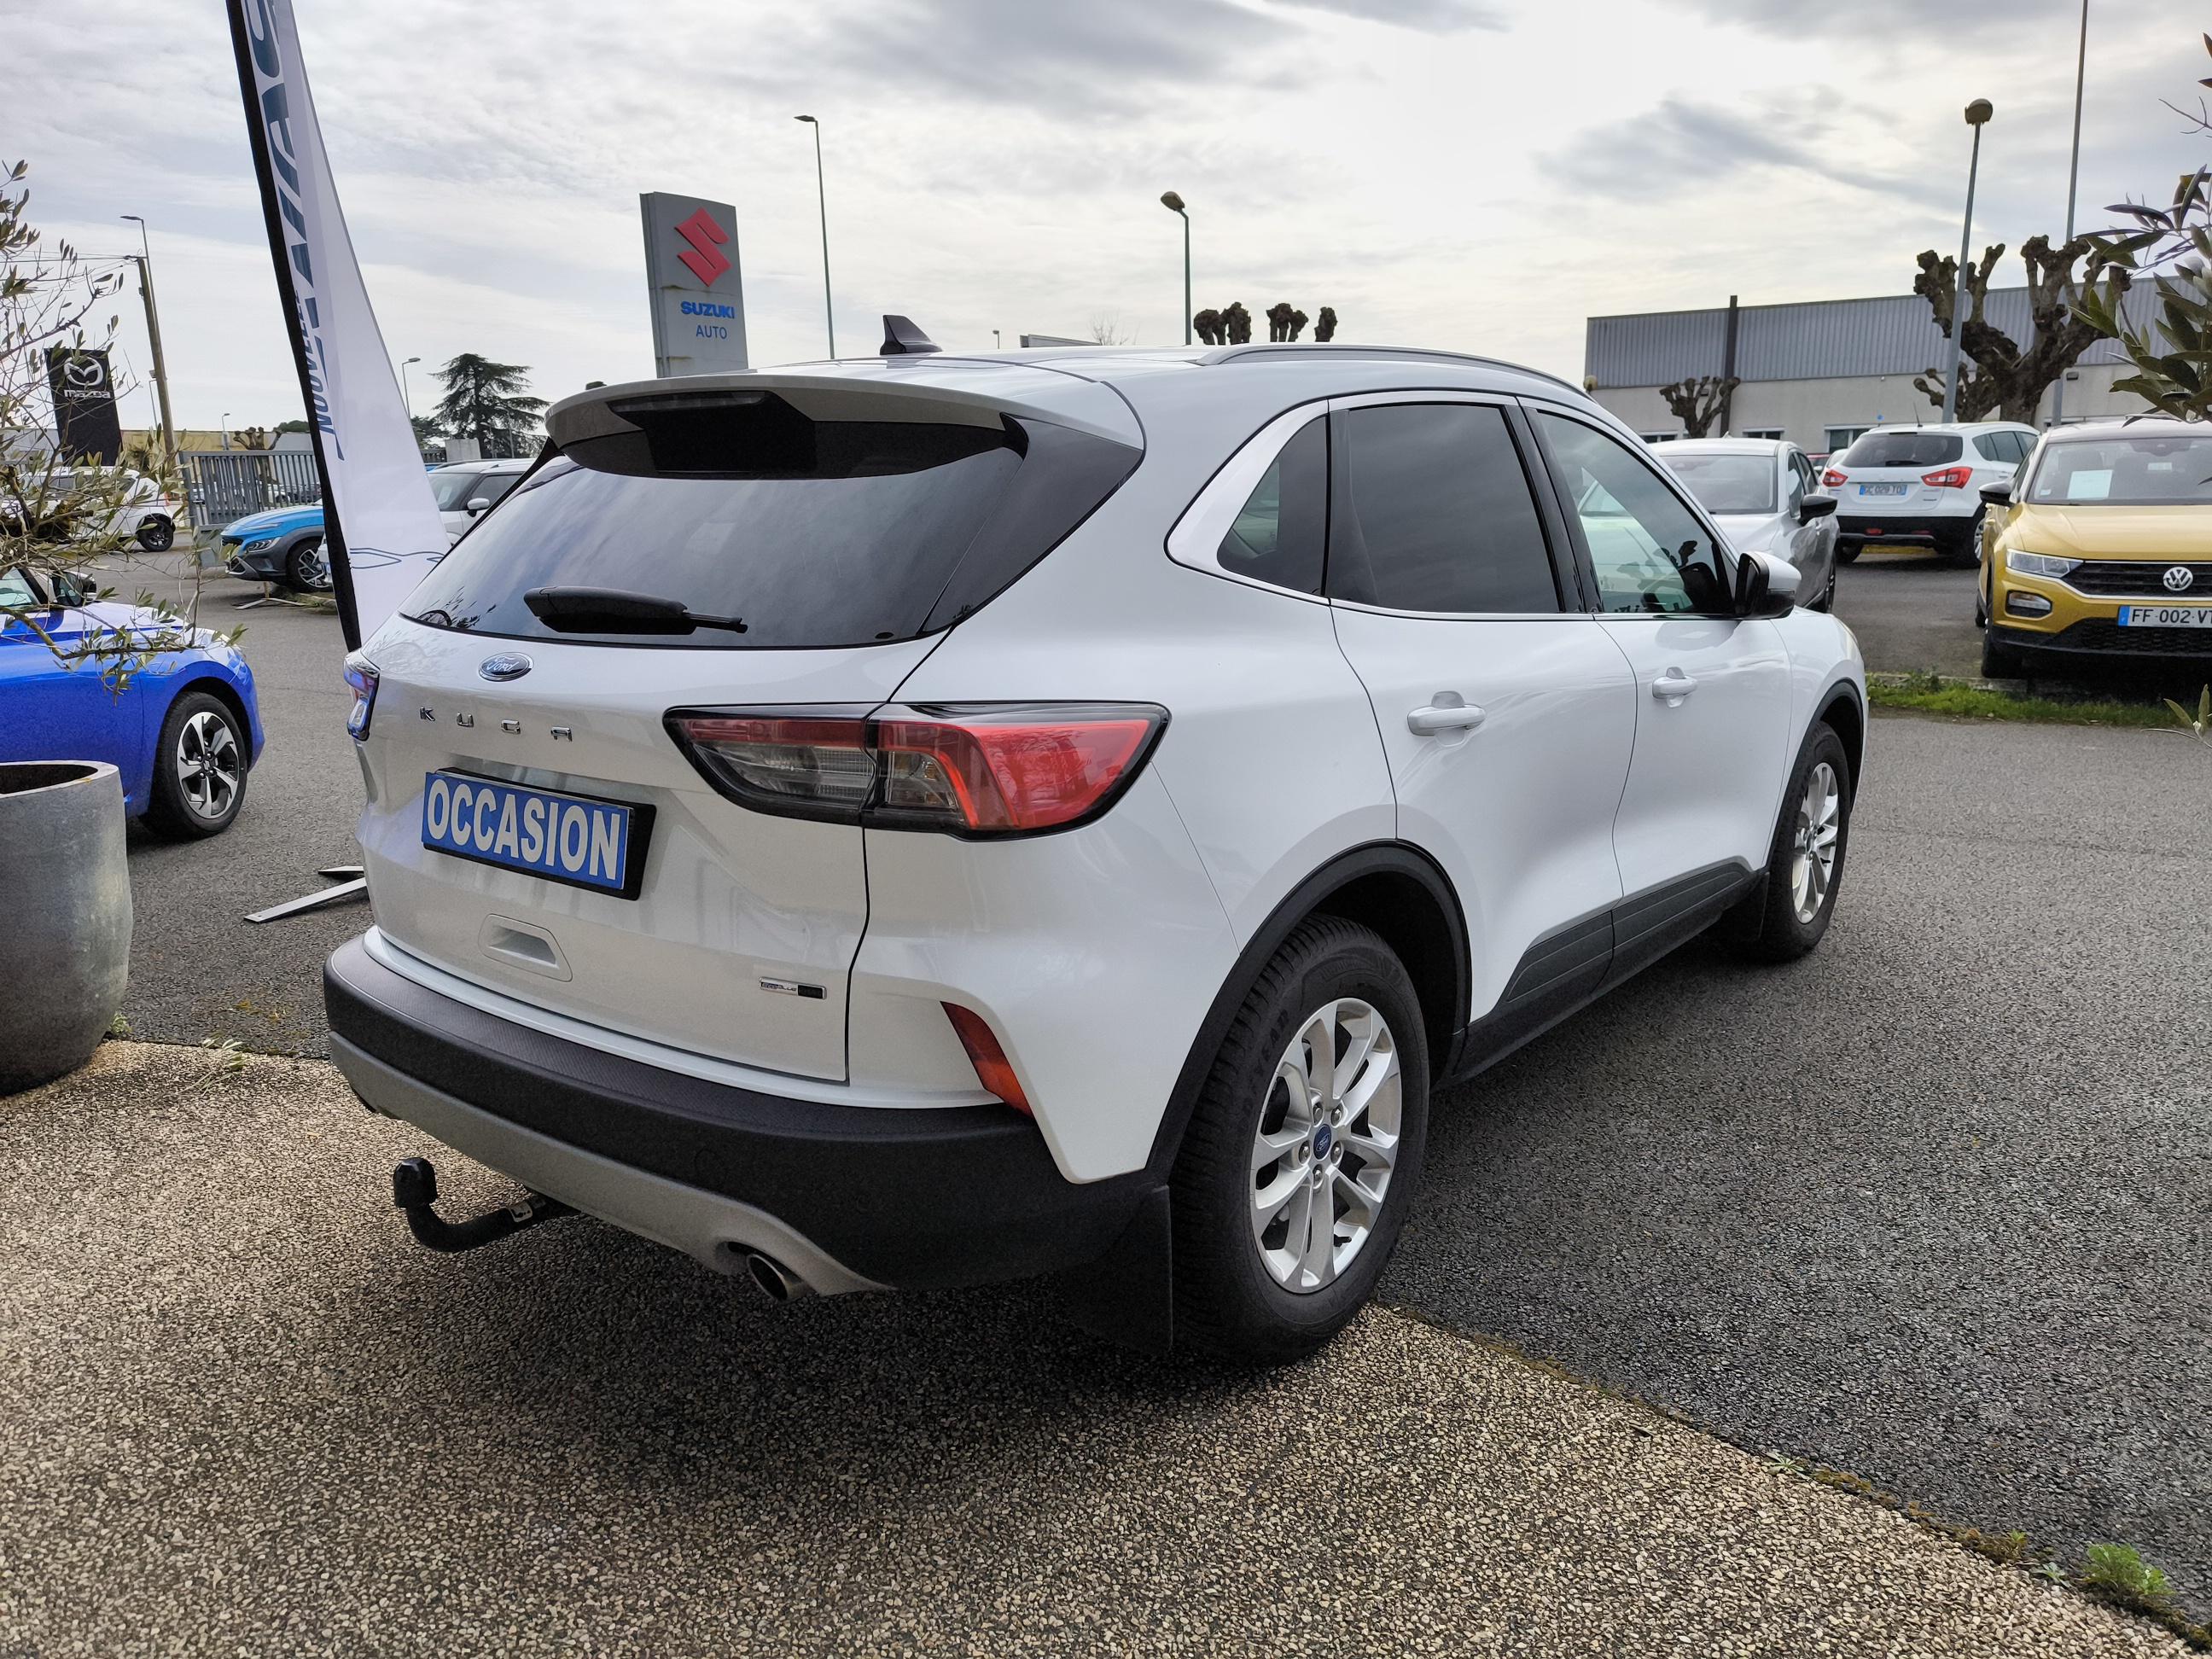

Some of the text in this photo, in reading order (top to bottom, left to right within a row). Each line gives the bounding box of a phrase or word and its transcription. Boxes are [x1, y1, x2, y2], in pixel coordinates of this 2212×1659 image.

[680, 300, 736, 319] SUZUKI
[696, 324, 728, 340] AUTO
[295, 289, 335, 435] NOUV
[486, 655, 521, 673] Ford
[419, 707, 573, 742] KUGA
[428, 778, 620, 881] OCCASION
